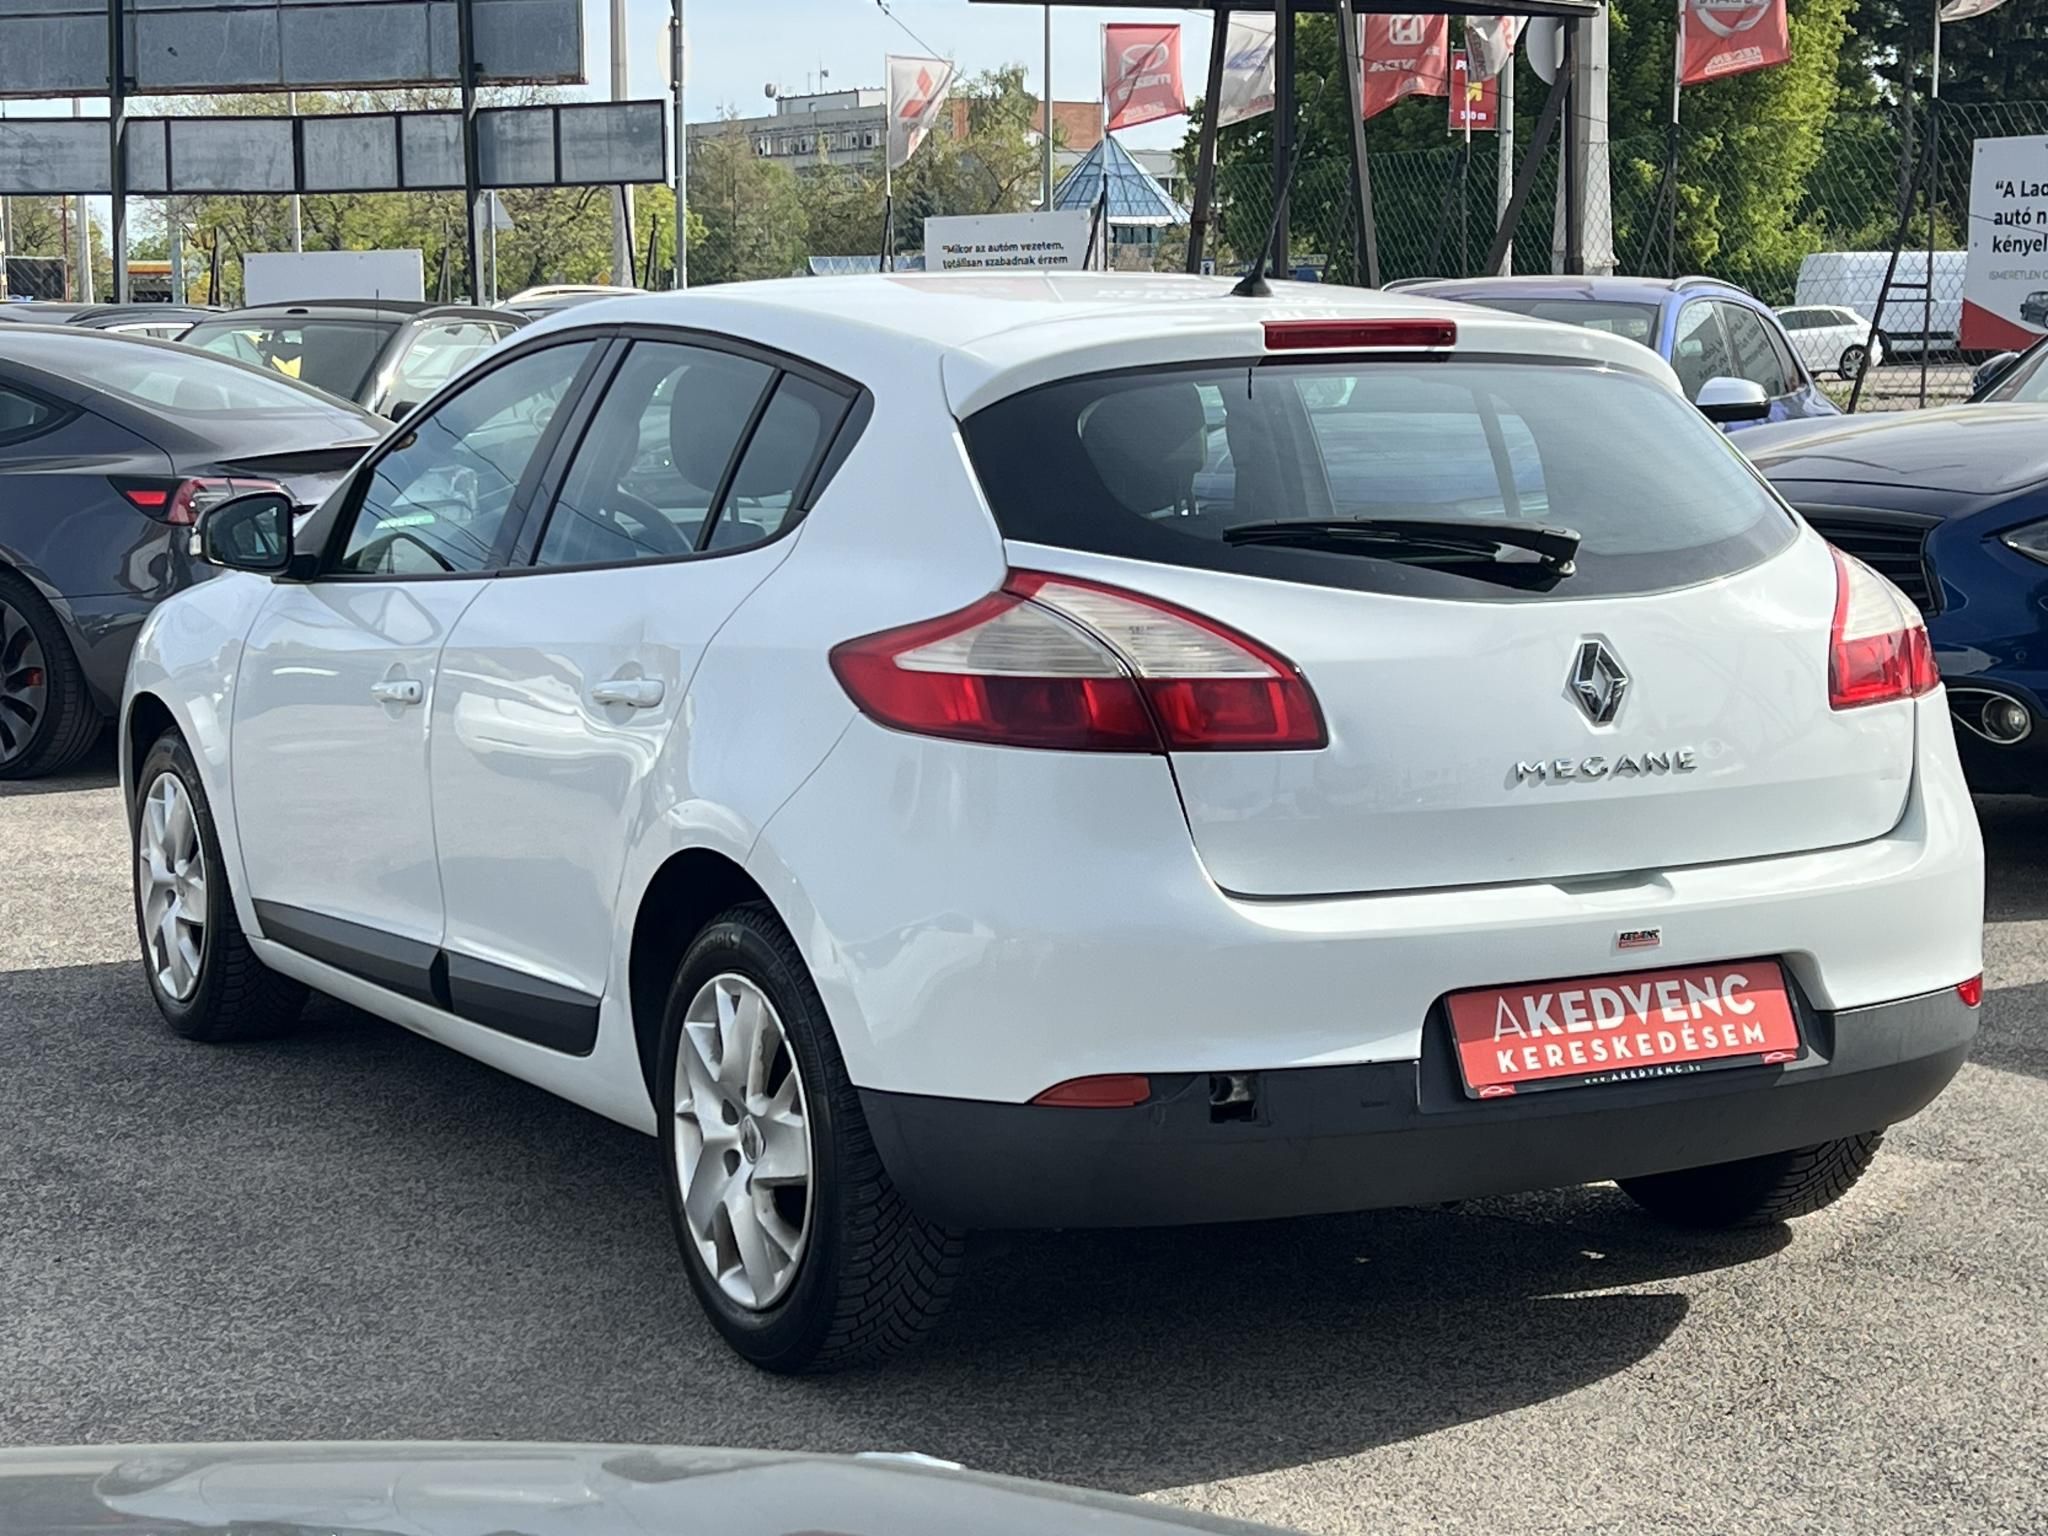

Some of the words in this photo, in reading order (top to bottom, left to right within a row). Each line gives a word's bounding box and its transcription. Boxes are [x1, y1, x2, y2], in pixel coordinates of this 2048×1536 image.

[1460, 110, 1477, 120] 50
[1993, 206, 2032, 226] autó
[975, 246, 986, 254] az
[988, 242, 1018, 253] autóm
[1992, 234, 2048, 257] kényel
[942, 256, 983, 269] totálisan
[985, 255, 1035, 267] szabadnak
[1037, 254, 1068, 265] érzem
[1988, 269, 2041, 281] ISMERETLEN
[1514, 745, 1698, 783] MEGANE
[1496, 1021, 1767, 1075] KERESKEDÉSEM
